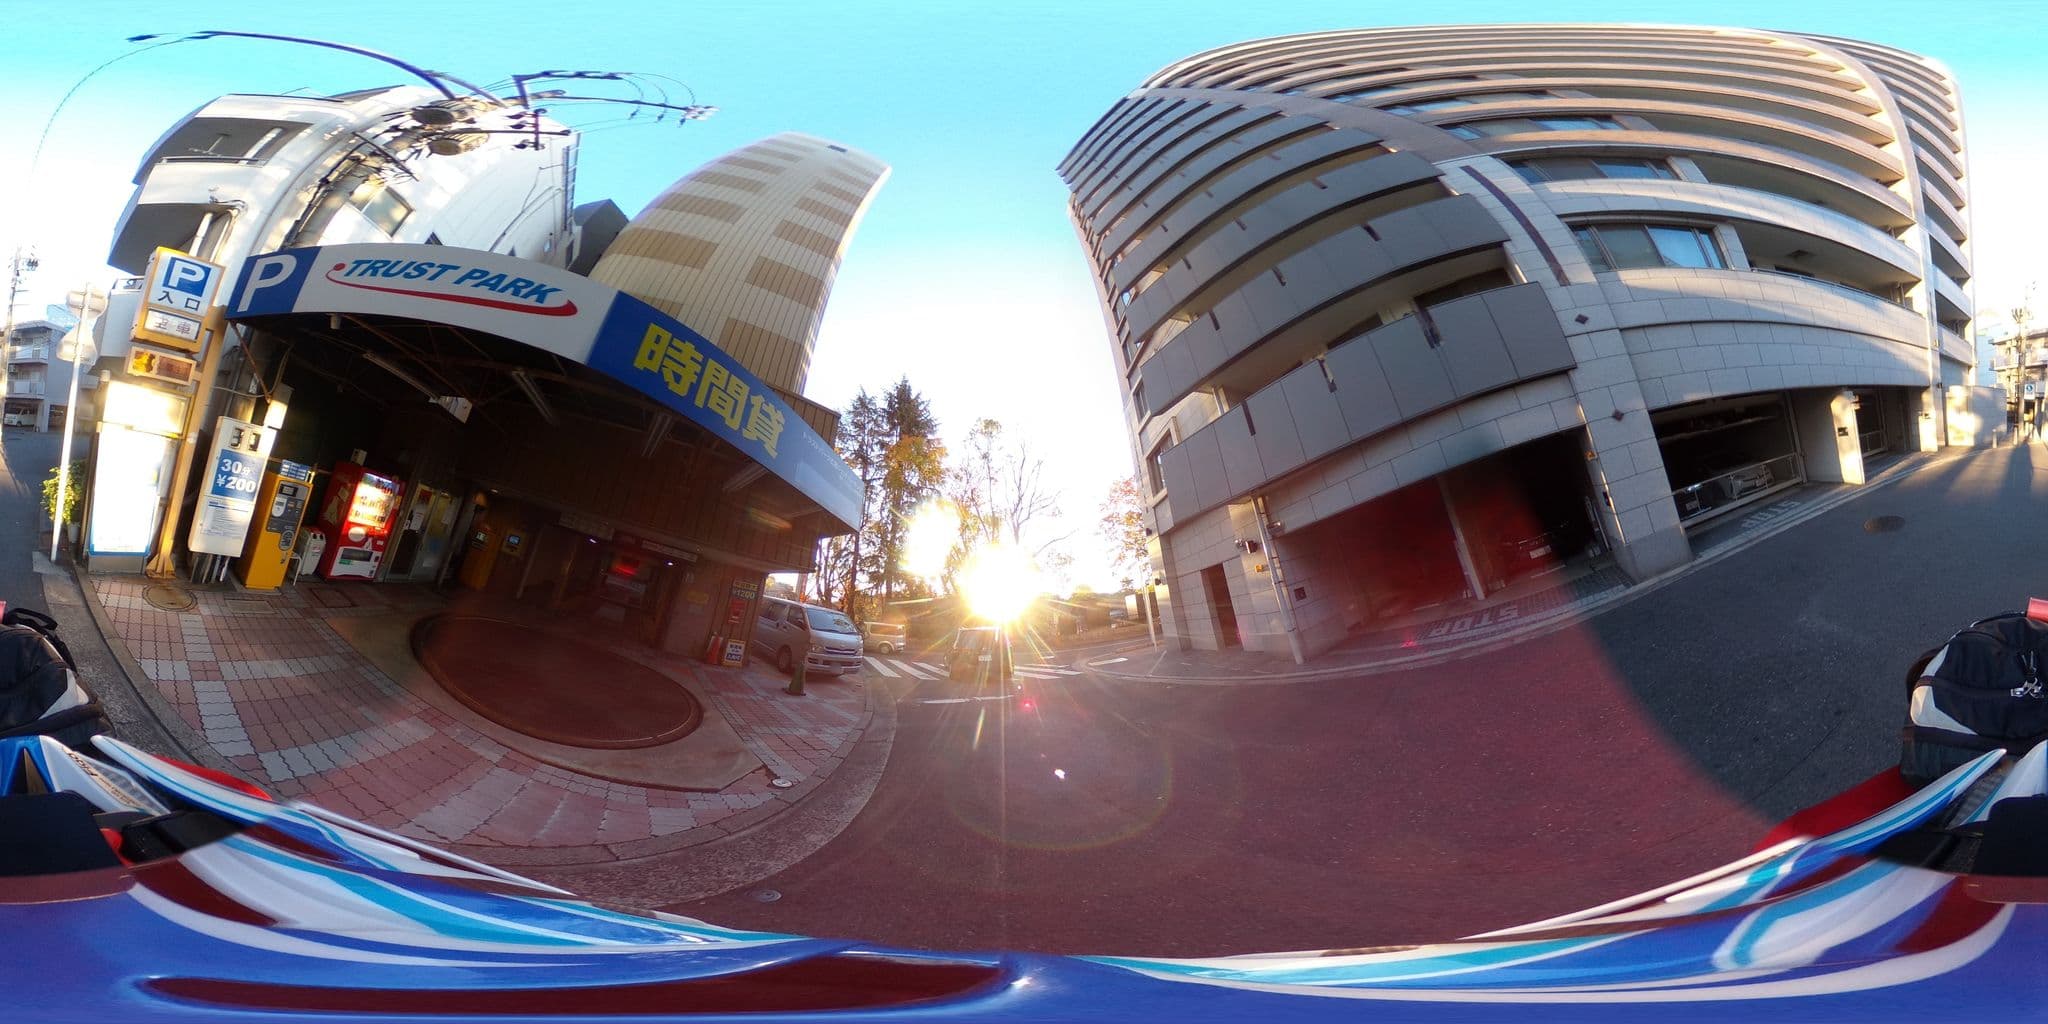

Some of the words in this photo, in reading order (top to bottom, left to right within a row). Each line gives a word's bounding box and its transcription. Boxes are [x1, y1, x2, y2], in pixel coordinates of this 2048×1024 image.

[168, 259, 206, 289] P
[238, 254, 297, 313] P
[344, 259, 460, 282] TRUST
[453, 268, 564, 304] PARK
[157, 290, 201, 311] 入口
[633, 322, 786, 460] 時間貸
[216, 473, 257, 494] ¥200
